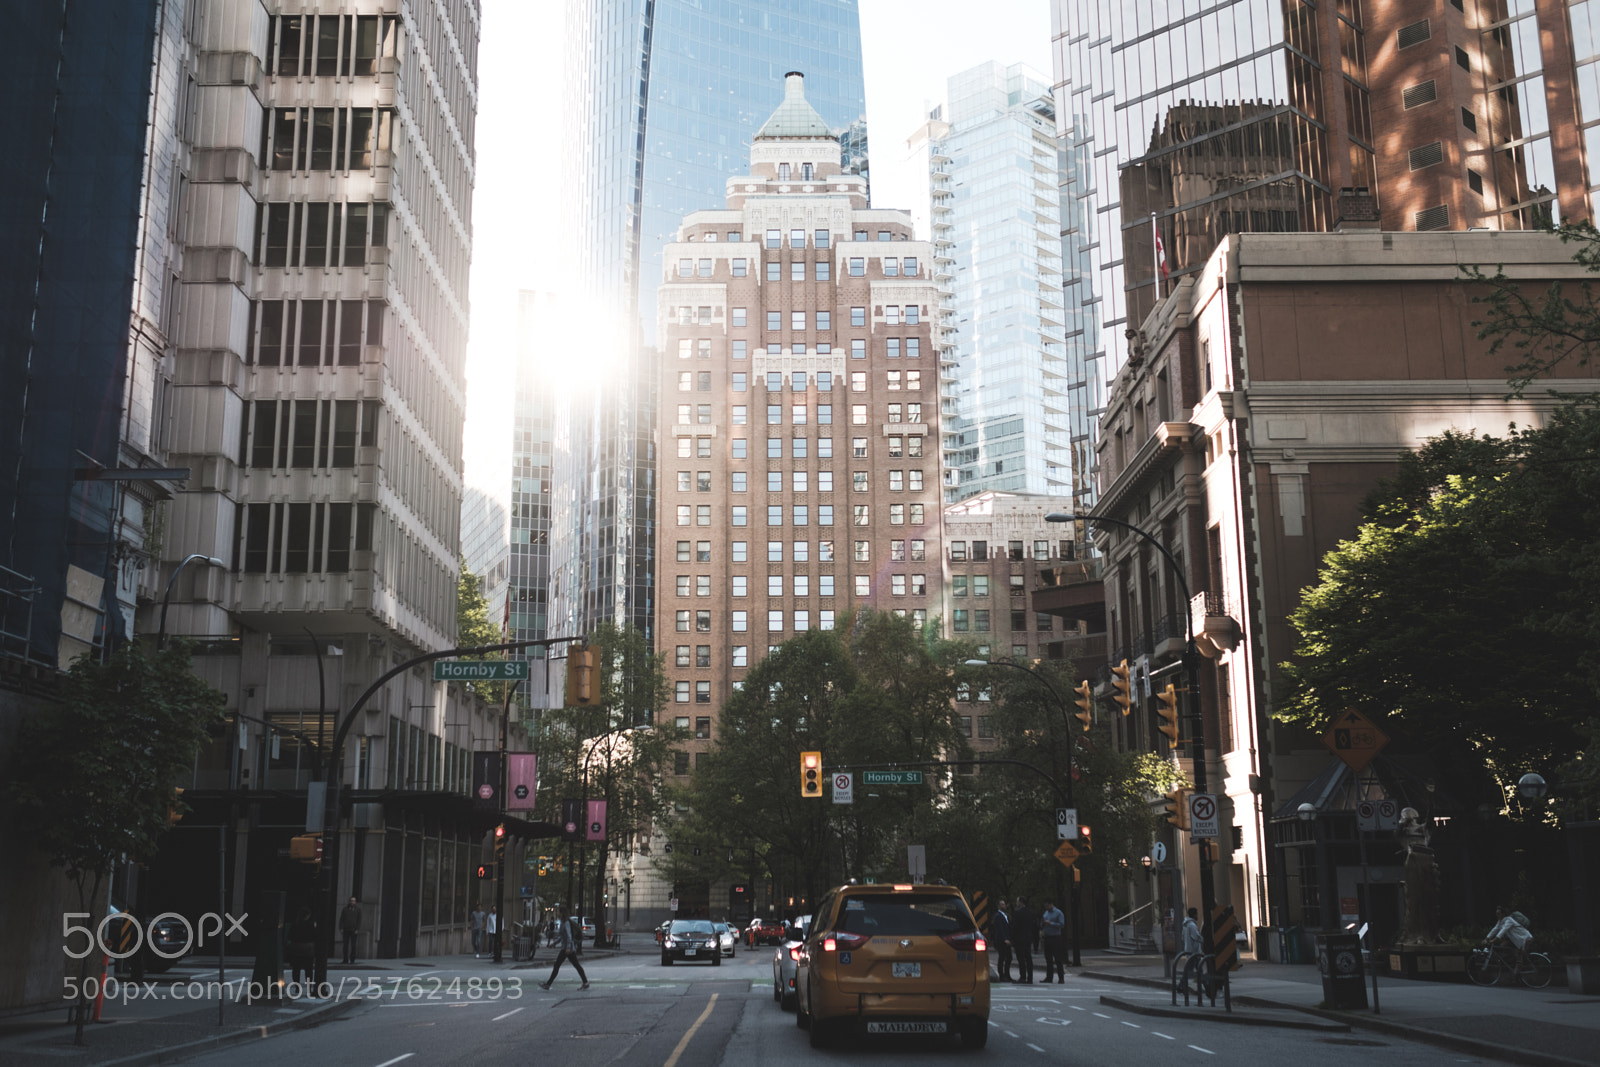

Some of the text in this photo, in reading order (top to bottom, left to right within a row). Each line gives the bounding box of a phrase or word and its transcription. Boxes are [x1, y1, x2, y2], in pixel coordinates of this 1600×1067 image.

[441, 663, 521, 678] Hornby St
[868, 773, 918, 783] Hornby St
[877, 1022, 937, 1032] MAHADEV
